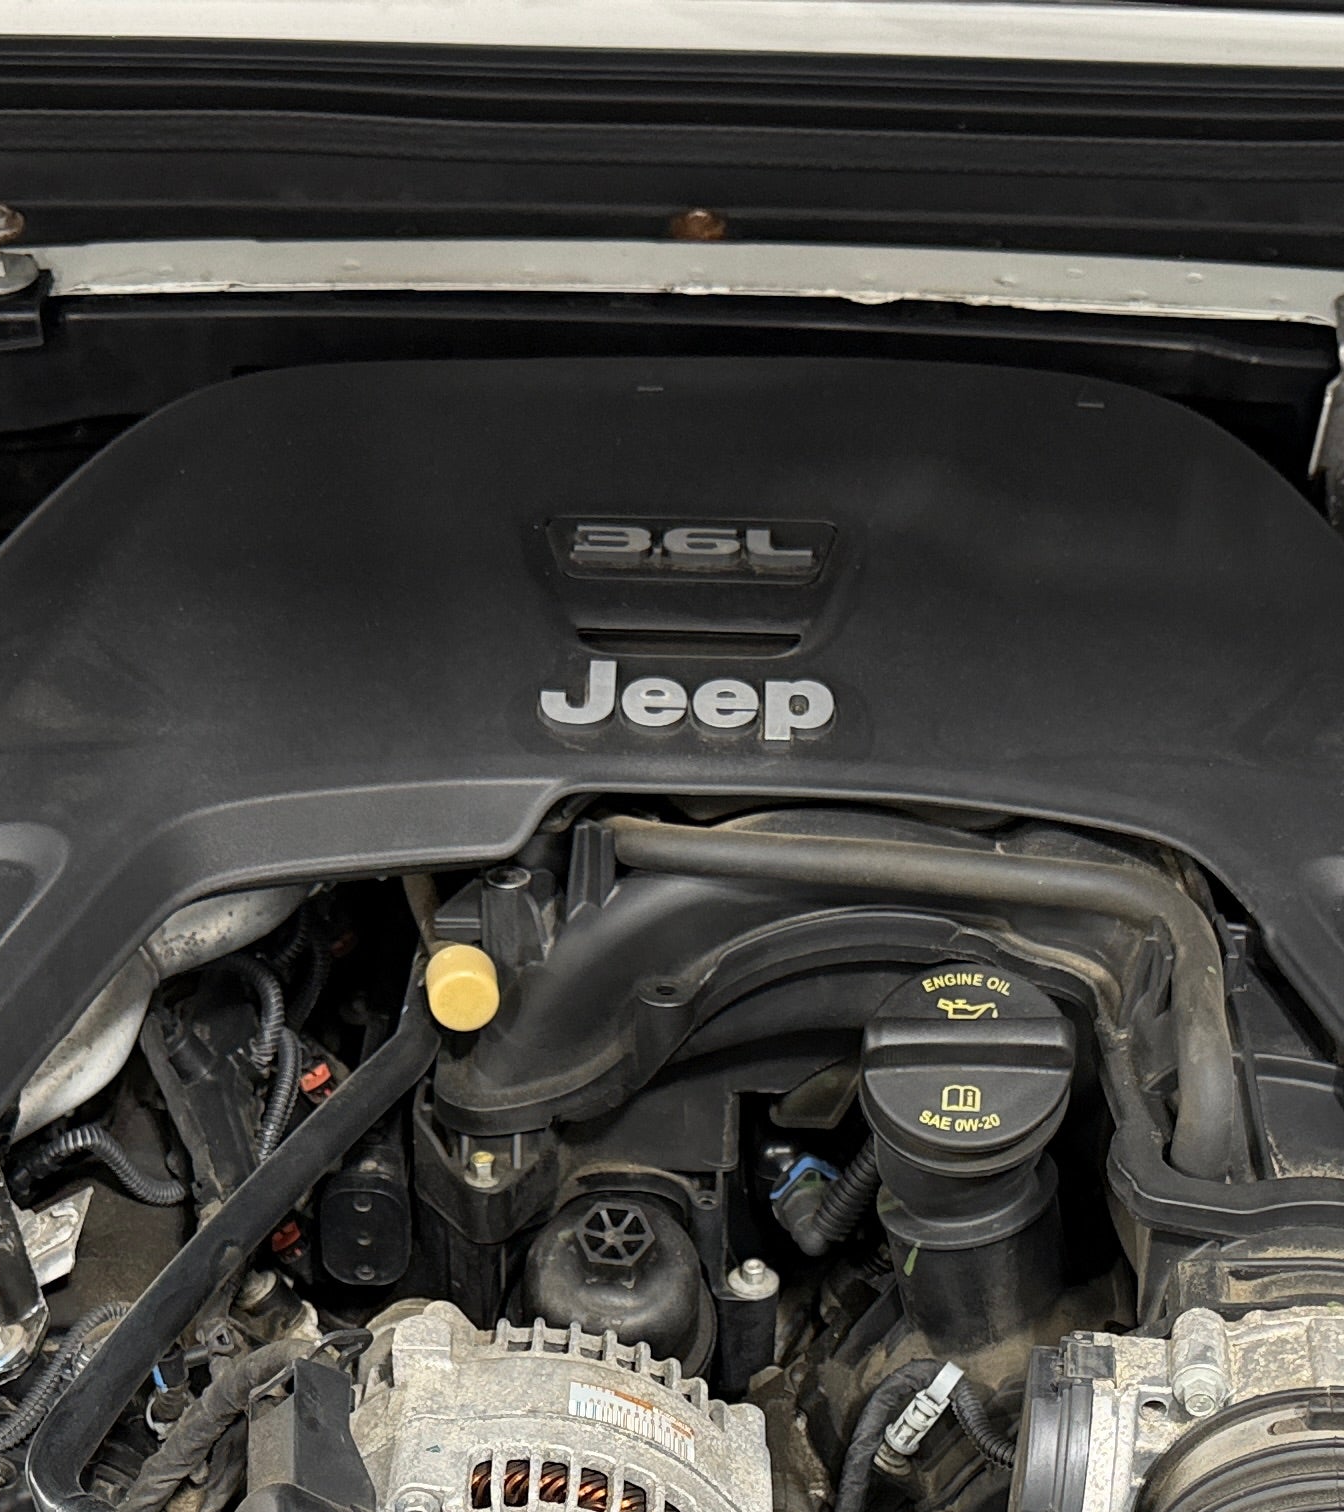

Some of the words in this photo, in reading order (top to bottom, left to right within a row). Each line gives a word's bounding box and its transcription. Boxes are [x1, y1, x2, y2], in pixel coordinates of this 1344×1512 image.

[571, 525, 813, 563] 3.6L
[540, 660, 834, 741] Jeep
[921, 973, 984, 993] ENGINE
[986, 977, 1012, 997] OIL
[919, 1110, 952, 1131] SAE
[954, 1113, 1001, 1132] 0W-20
